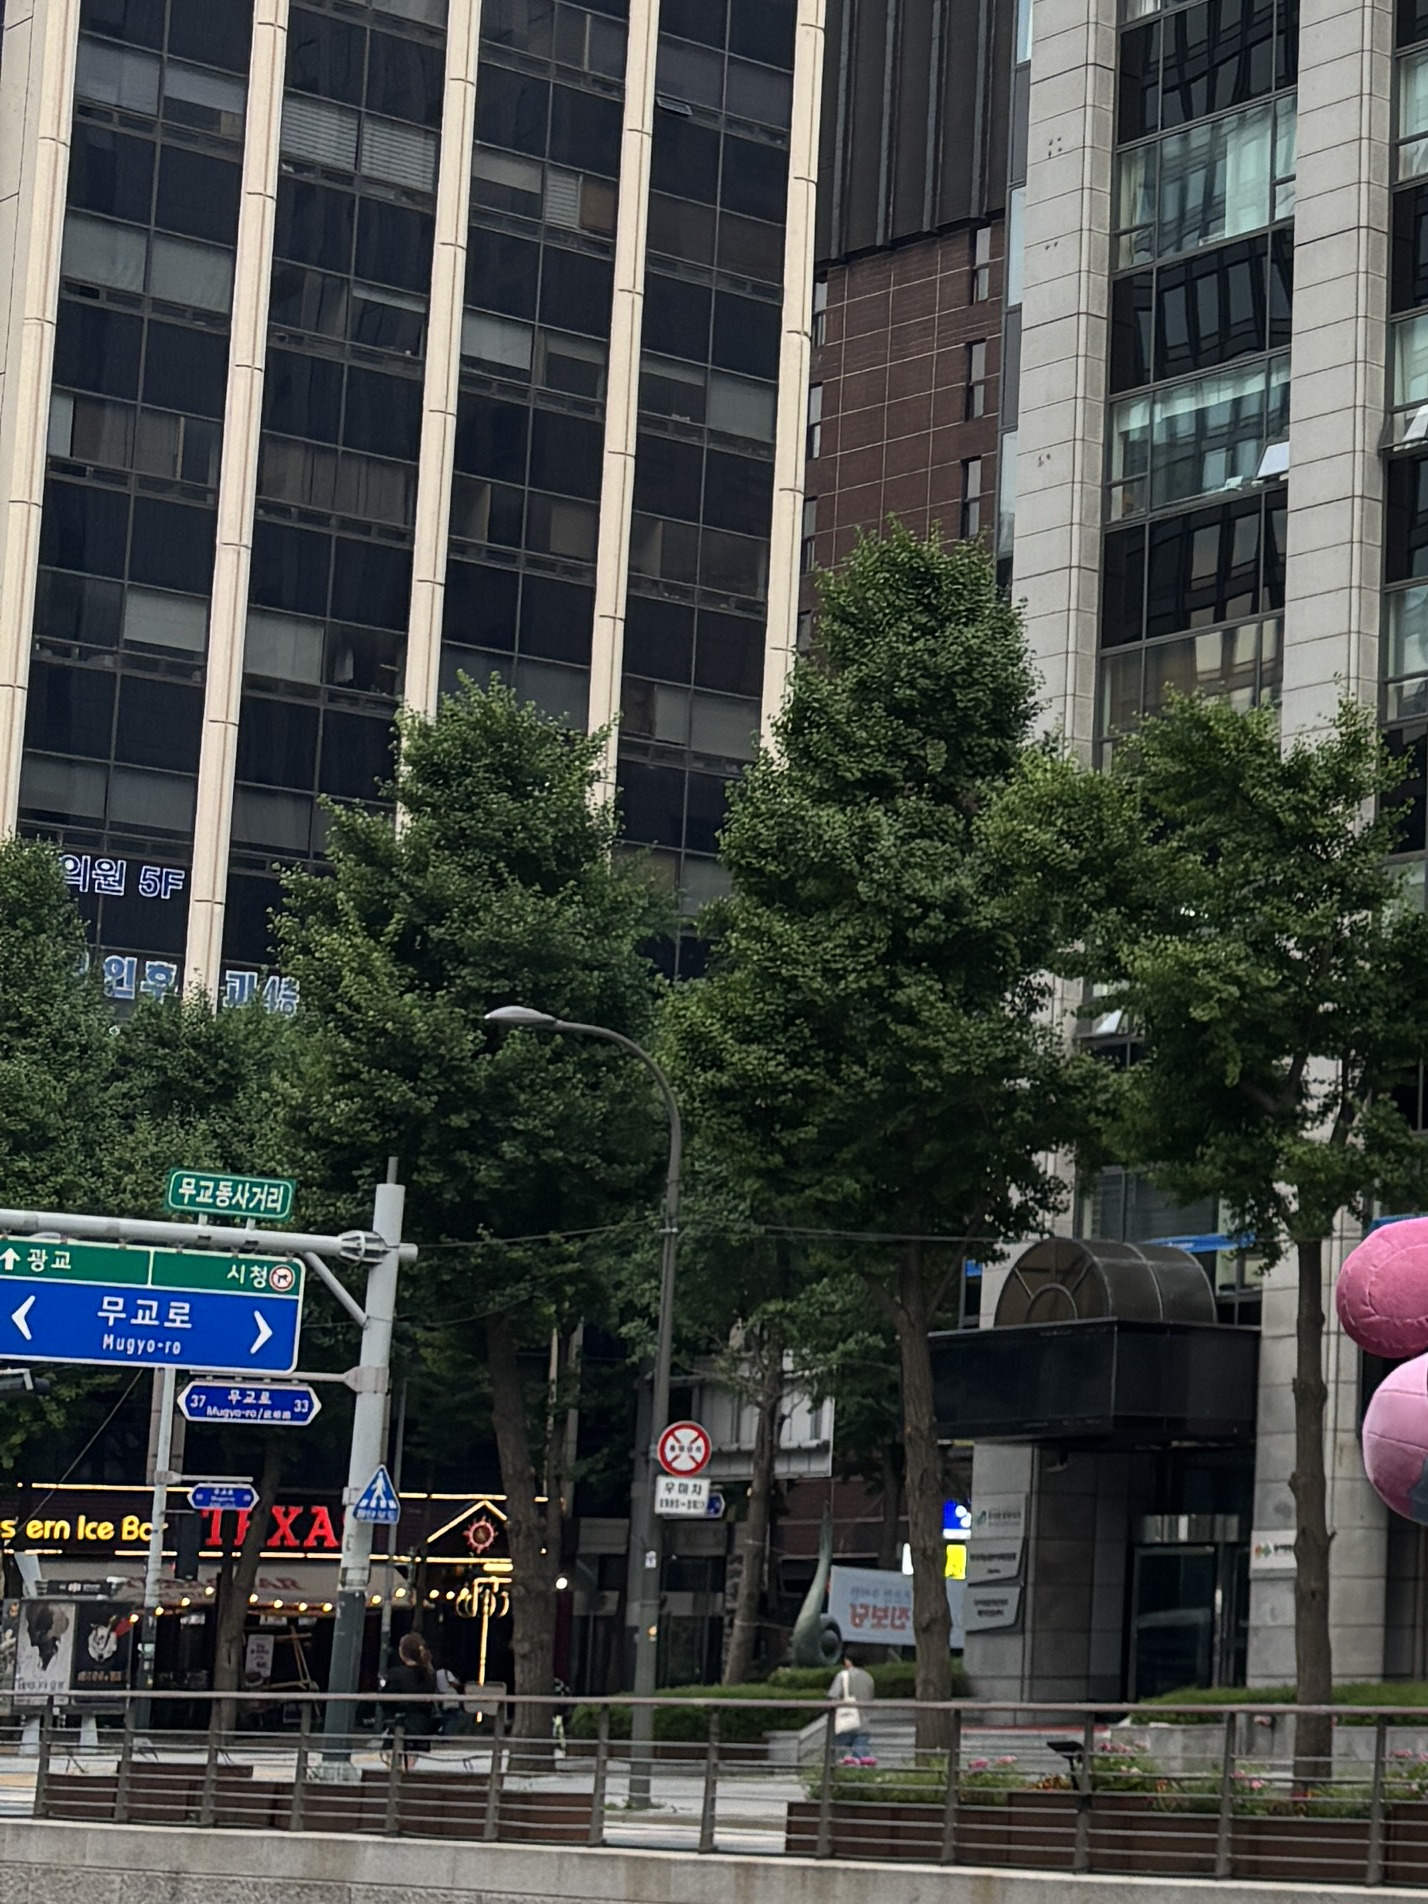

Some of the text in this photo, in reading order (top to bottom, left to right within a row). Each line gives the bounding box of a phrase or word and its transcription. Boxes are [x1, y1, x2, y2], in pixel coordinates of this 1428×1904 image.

[138, 865, 186, 899] 5F
[178, 1176, 285, 1213] 무교동사거리
[27, 1248, 72, 1273] 광교
[226, 1263, 269, 1289] 시청
[97, 1296, 192, 1329] 무교로
[102, 1334, 182, 1356] Mugyo-ro
[189, 1394, 206, 1408] 37
[294, 1399, 309, 1413] 33
[0, 1515, 169, 1541] sern Ice Ba
[200, 1505, 343, 1547] TXA
